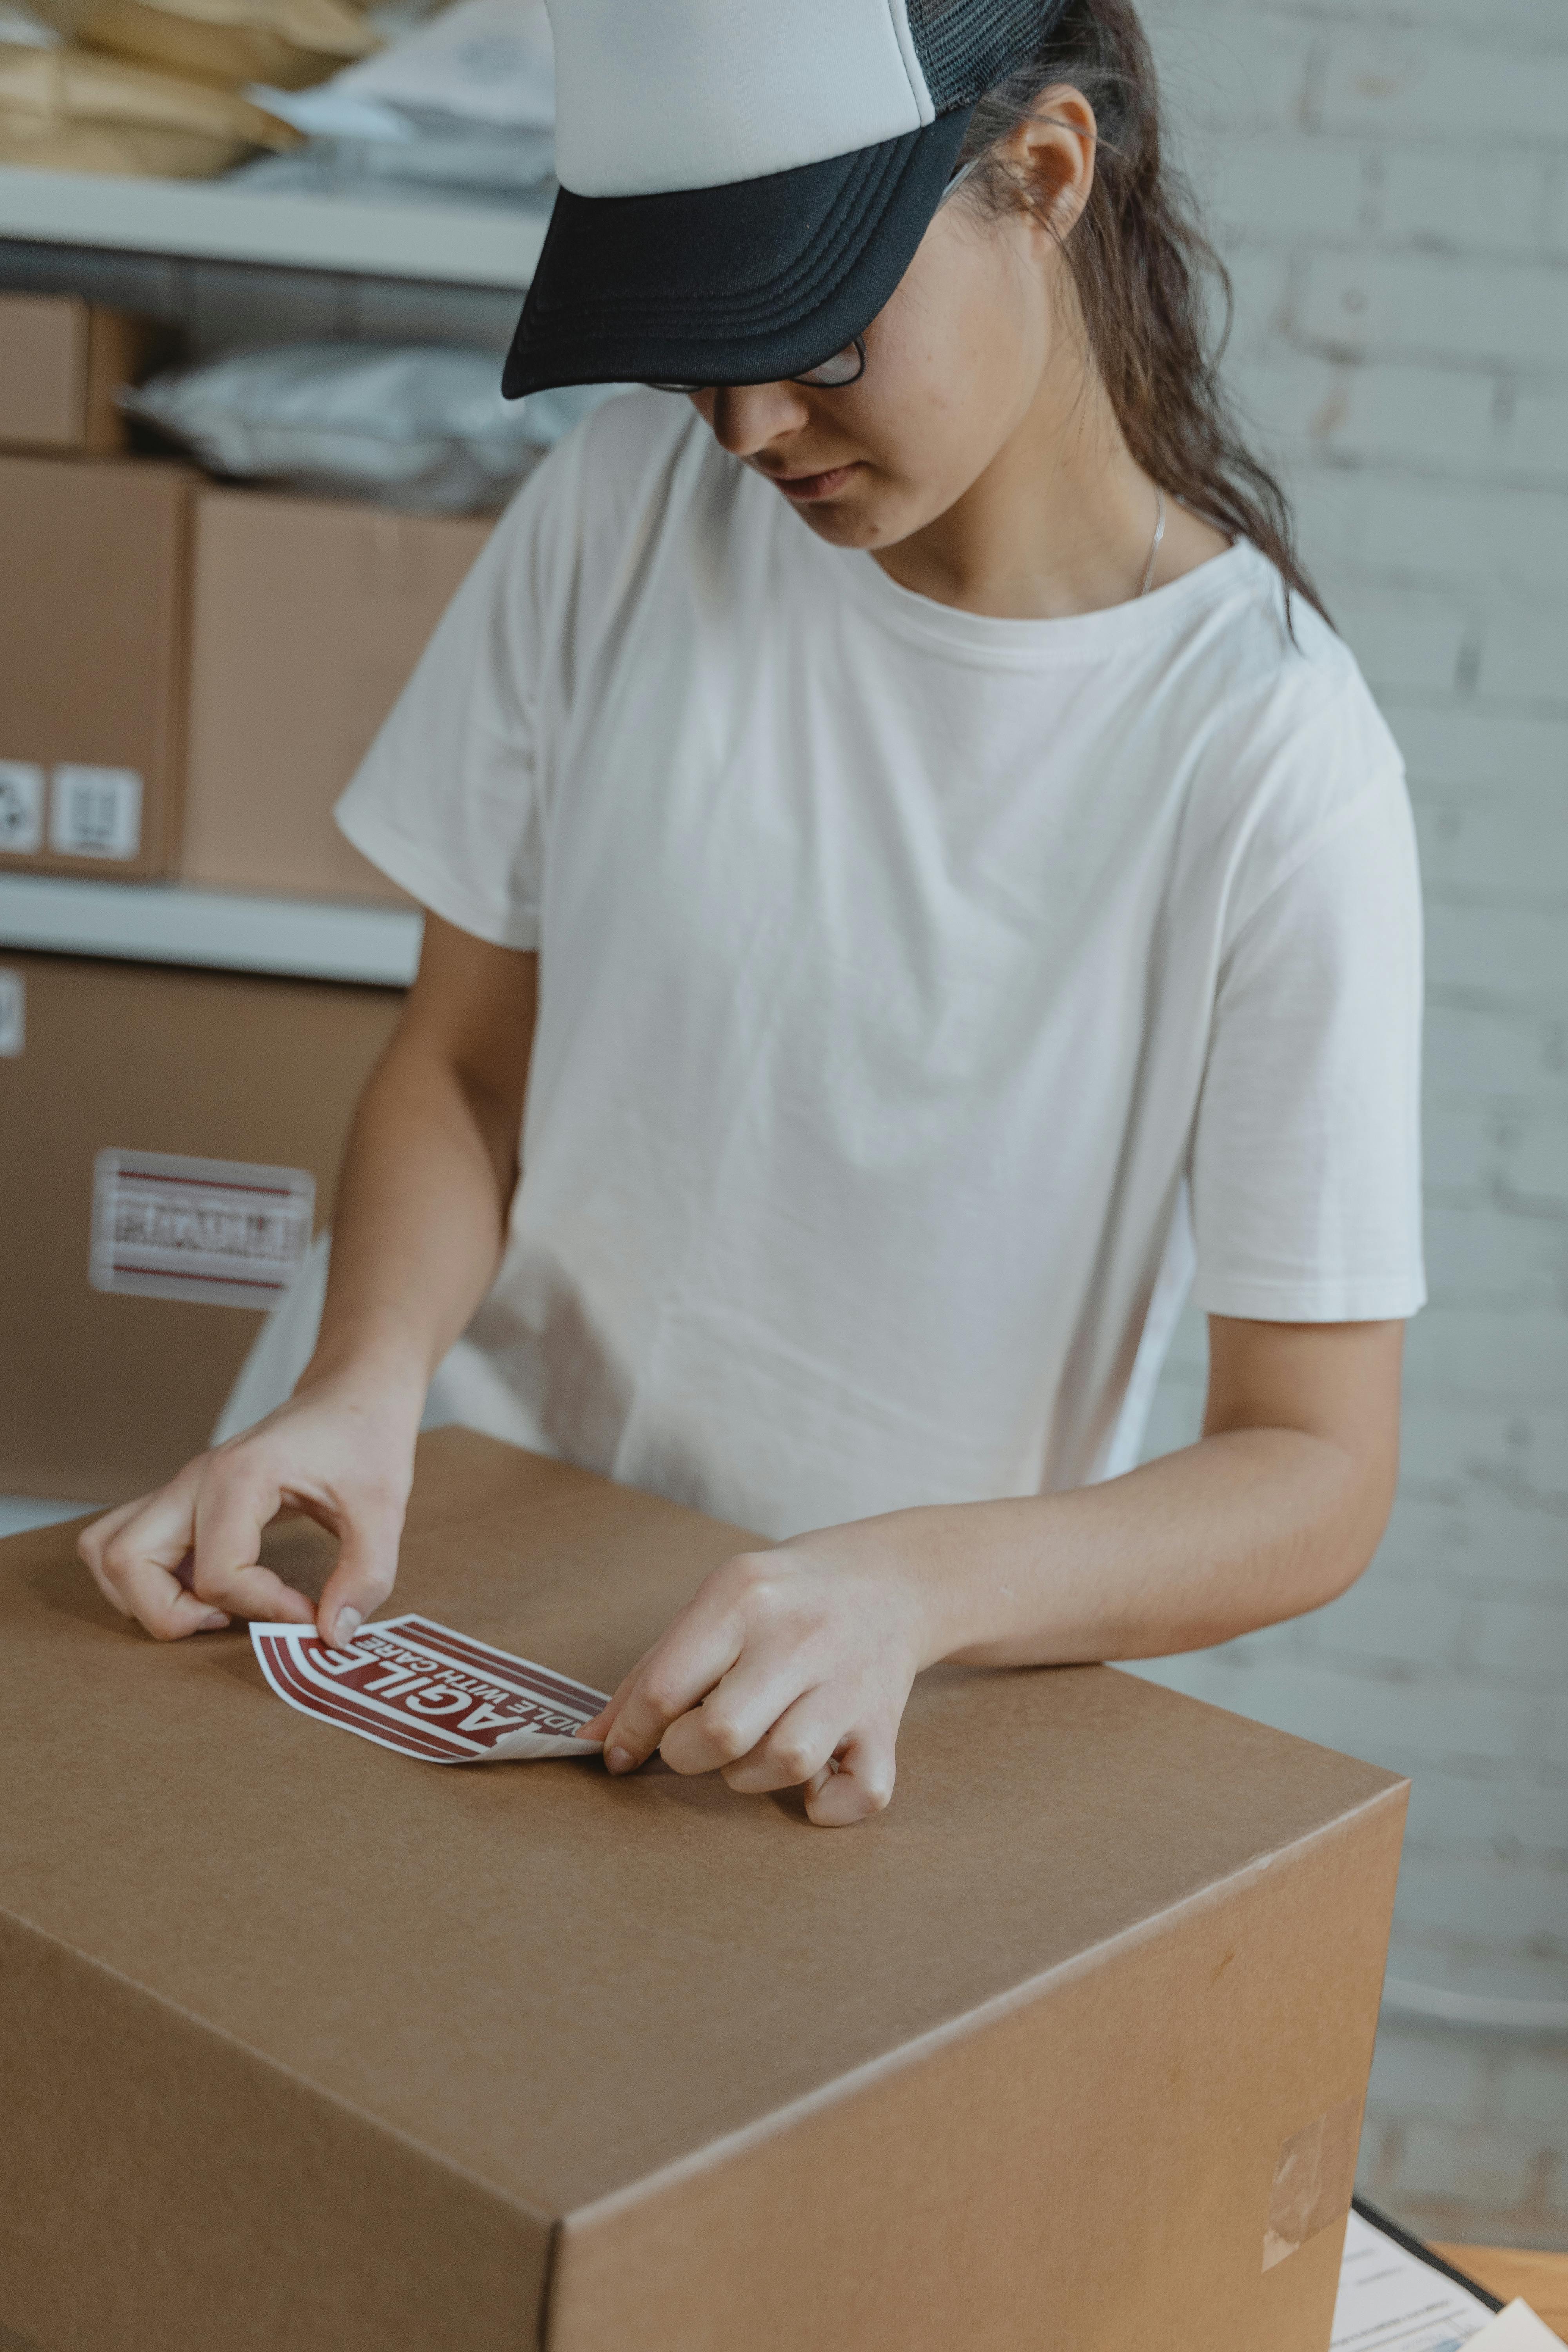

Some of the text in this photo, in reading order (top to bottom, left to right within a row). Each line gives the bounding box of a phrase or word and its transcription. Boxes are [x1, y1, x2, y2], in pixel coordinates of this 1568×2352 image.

[308, 1643, 543, 1744] AGILE
[355, 1637, 582, 1736] NDLE WITH CARE
